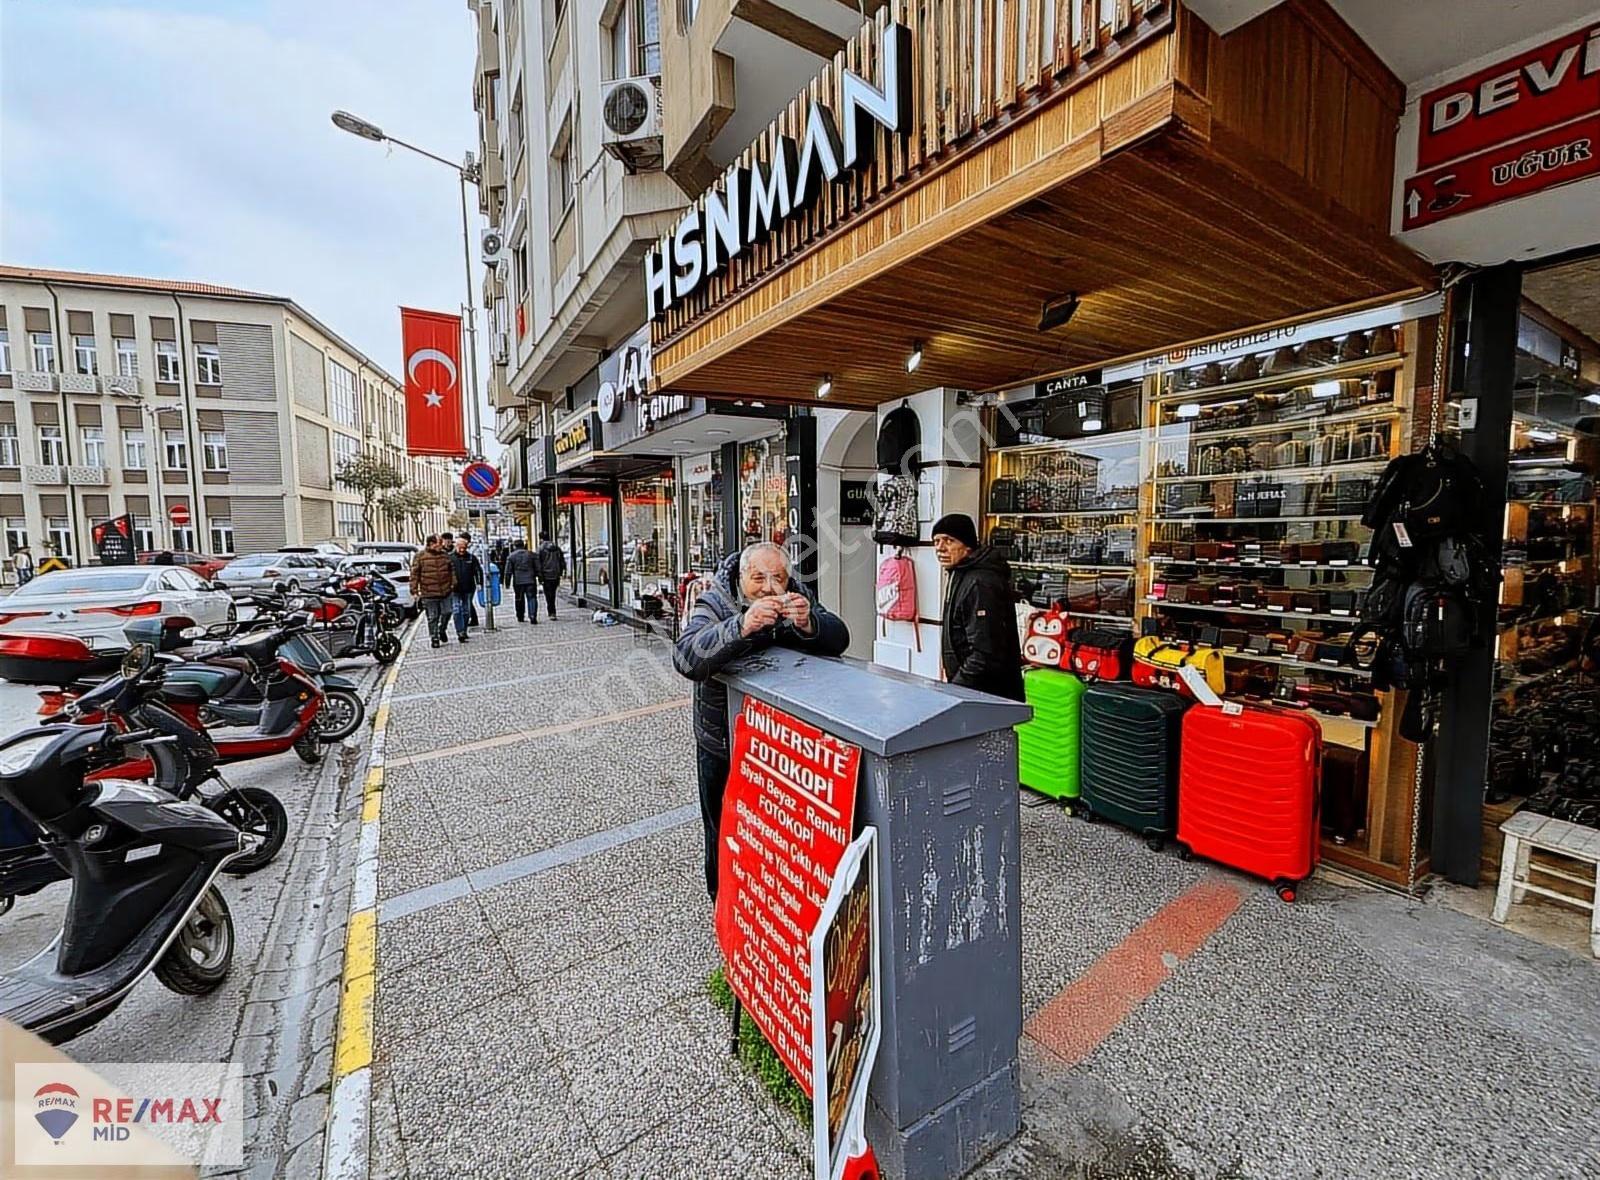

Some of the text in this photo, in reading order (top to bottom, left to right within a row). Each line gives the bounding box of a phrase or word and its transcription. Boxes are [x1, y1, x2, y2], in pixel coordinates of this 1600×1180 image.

[645, 22, 900, 321] HSNMAN
[1492, 138, 1592, 186] UĞUR
[1046, 375, 1088, 396] ÇANTA
[745, 704, 848, 779] ÜNİVERSİTE
[750, 736, 833, 804] FOTOKOPİ
[736, 799, 788, 853] Bilgisayardan
[740, 761, 764, 788] Siyah
[766, 777, 796, 811] Beyaz
[806, 805, 846, 847] Renkli
[759, 793, 814, 849] FOTOKOPİ
[732, 859, 745, 880] Her
[746, 872, 766, 904] Türlü
[737, 821, 763, 856] Doktora
[775, 851, 804, 894] Yüksek
[733, 905, 759, 947] Toplu
[738, 888, 754, 915] PVC
[755, 906, 791, 957] Kaplama
[729, 961, 749, 1000] Yaka
[744, 939, 810, 1030] ÖZEL FİYAT
